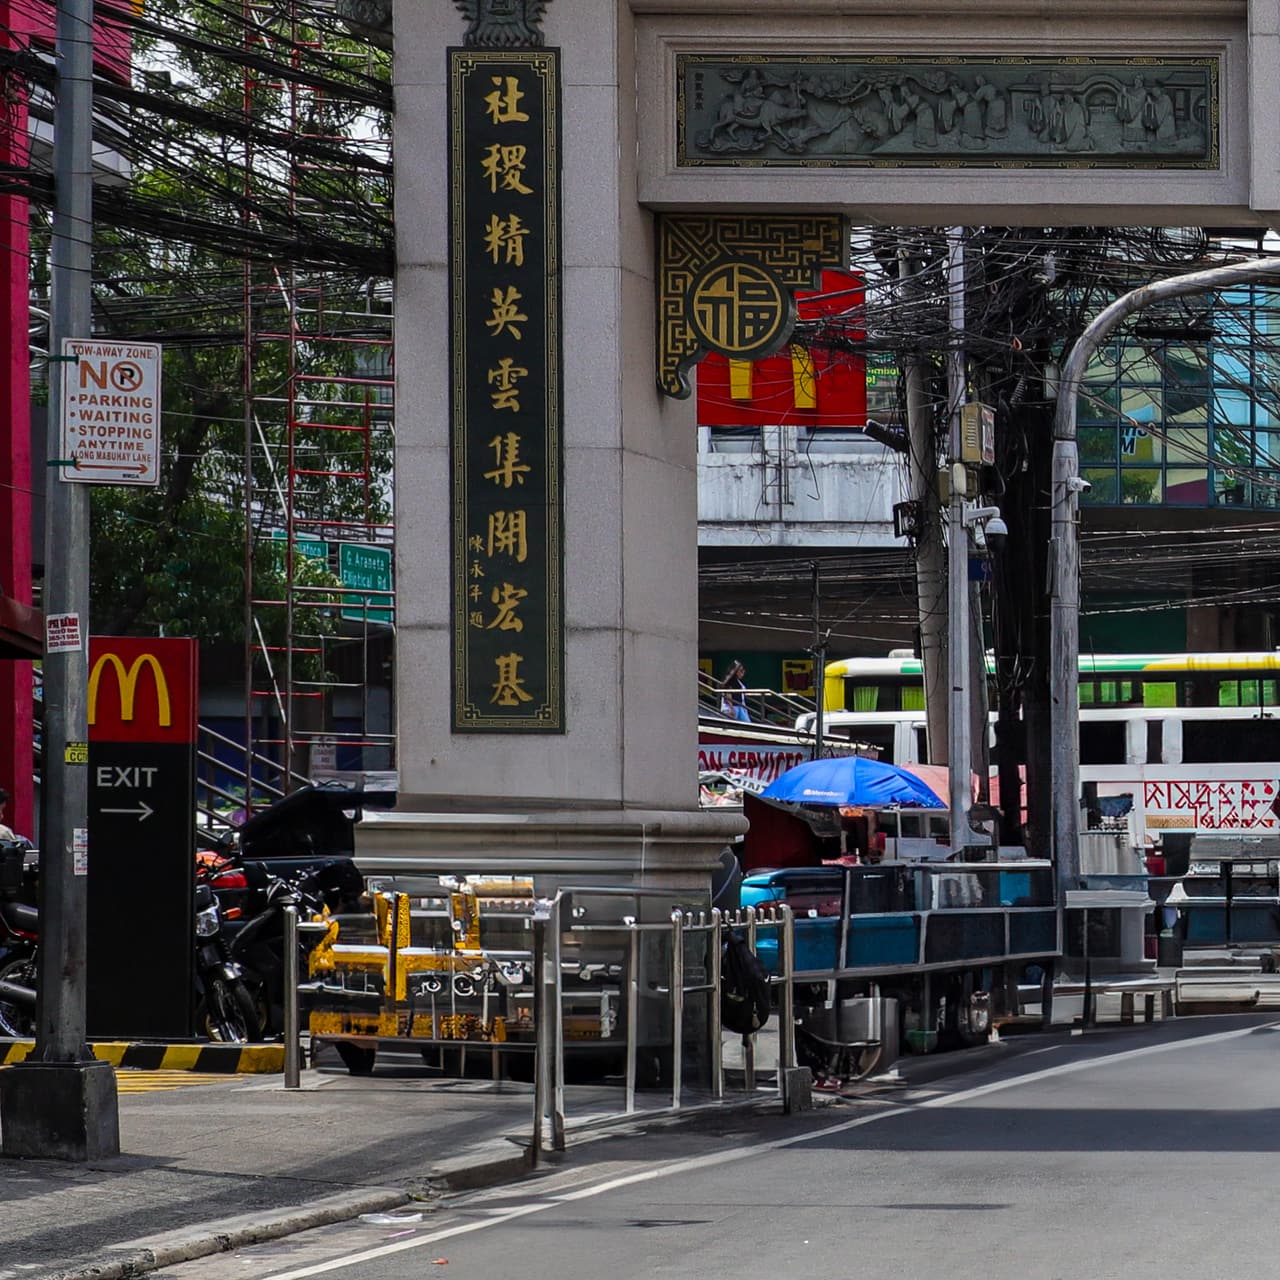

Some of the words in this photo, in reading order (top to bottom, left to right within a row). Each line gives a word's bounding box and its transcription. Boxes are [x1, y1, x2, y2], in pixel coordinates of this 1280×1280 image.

[72, 345, 124, 358] TOW-AWAY
[126, 348, 153, 359] ZONE
[480, 76, 534, 706] 社稷精英雲集開宏基
[79, 394, 153, 408] PARKING
[80, 410, 153, 424] WAITING
[79, 425, 153, 439] STOPPING
[78, 440, 144, 451] ANYTIME
[71, 450, 95, 460] ALONG
[132, 452, 152, 462] LANE
[97, 767, 158, 788] EXIT
